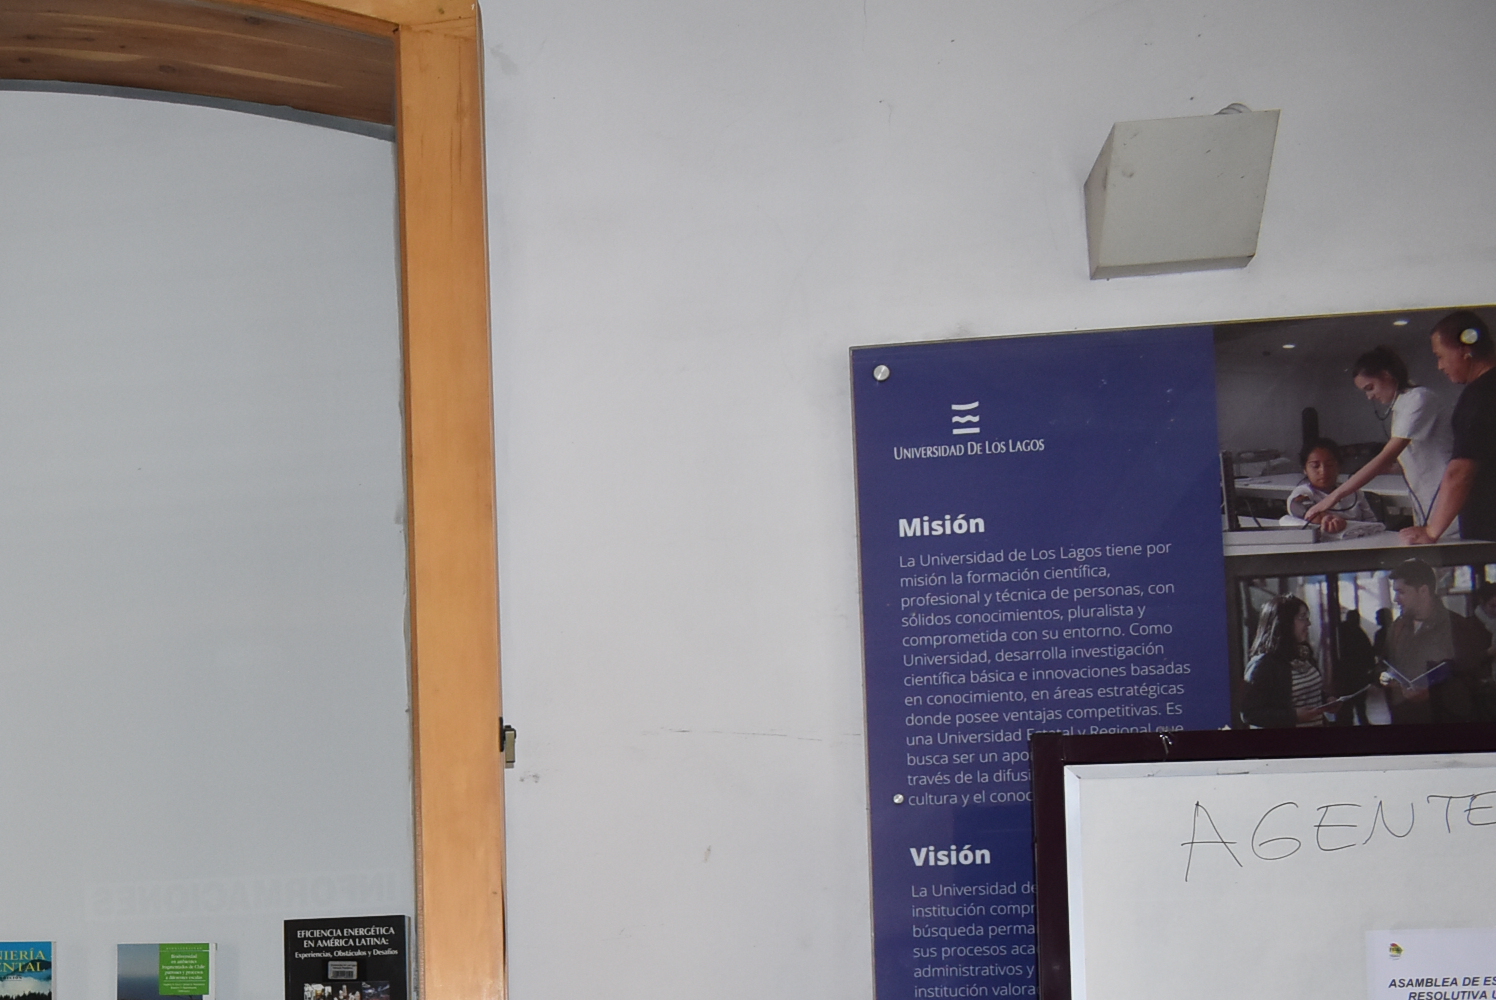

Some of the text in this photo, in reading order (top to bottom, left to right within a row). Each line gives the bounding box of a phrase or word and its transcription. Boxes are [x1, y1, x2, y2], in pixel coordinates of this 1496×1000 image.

[898, 514, 985, 538] Misión
[900, 543, 1172, 568] La Universidad de Los Lagos tiene por
[900, 565, 1111, 588] misión la formación científica,
[901, 583, 1175, 609] profesional y técnica de personas, con
[901, 603, 1146, 627] sólidos conocimientos, pluralista y
[903, 622, 1173, 649] comprometida con su entorno. Como
[904, 642, 1164, 668] Universidad, desarrolla investigación
[904, 661, 1191, 687] científica básica e innovaciones basadas
[905, 683, 1184, 707] en conocimiento, en áreas estratégicas
[906, 702, 1183, 727] donde posee ventajas competitivas. Es
[907, 728, 1022, 747] una Universidad
[907, 751, 997, 766] busca ser un
[910, 845, 991, 867] Visión
[911, 881, 1017, 898] La Universidad
[297, 925, 395, 938] EFICIENCIA ENERGÉTICA
[303, 937, 389, 948] EN AMÉRICA LATINA:
[1388, 976, 1481, 989] ASAMBLEA DE
